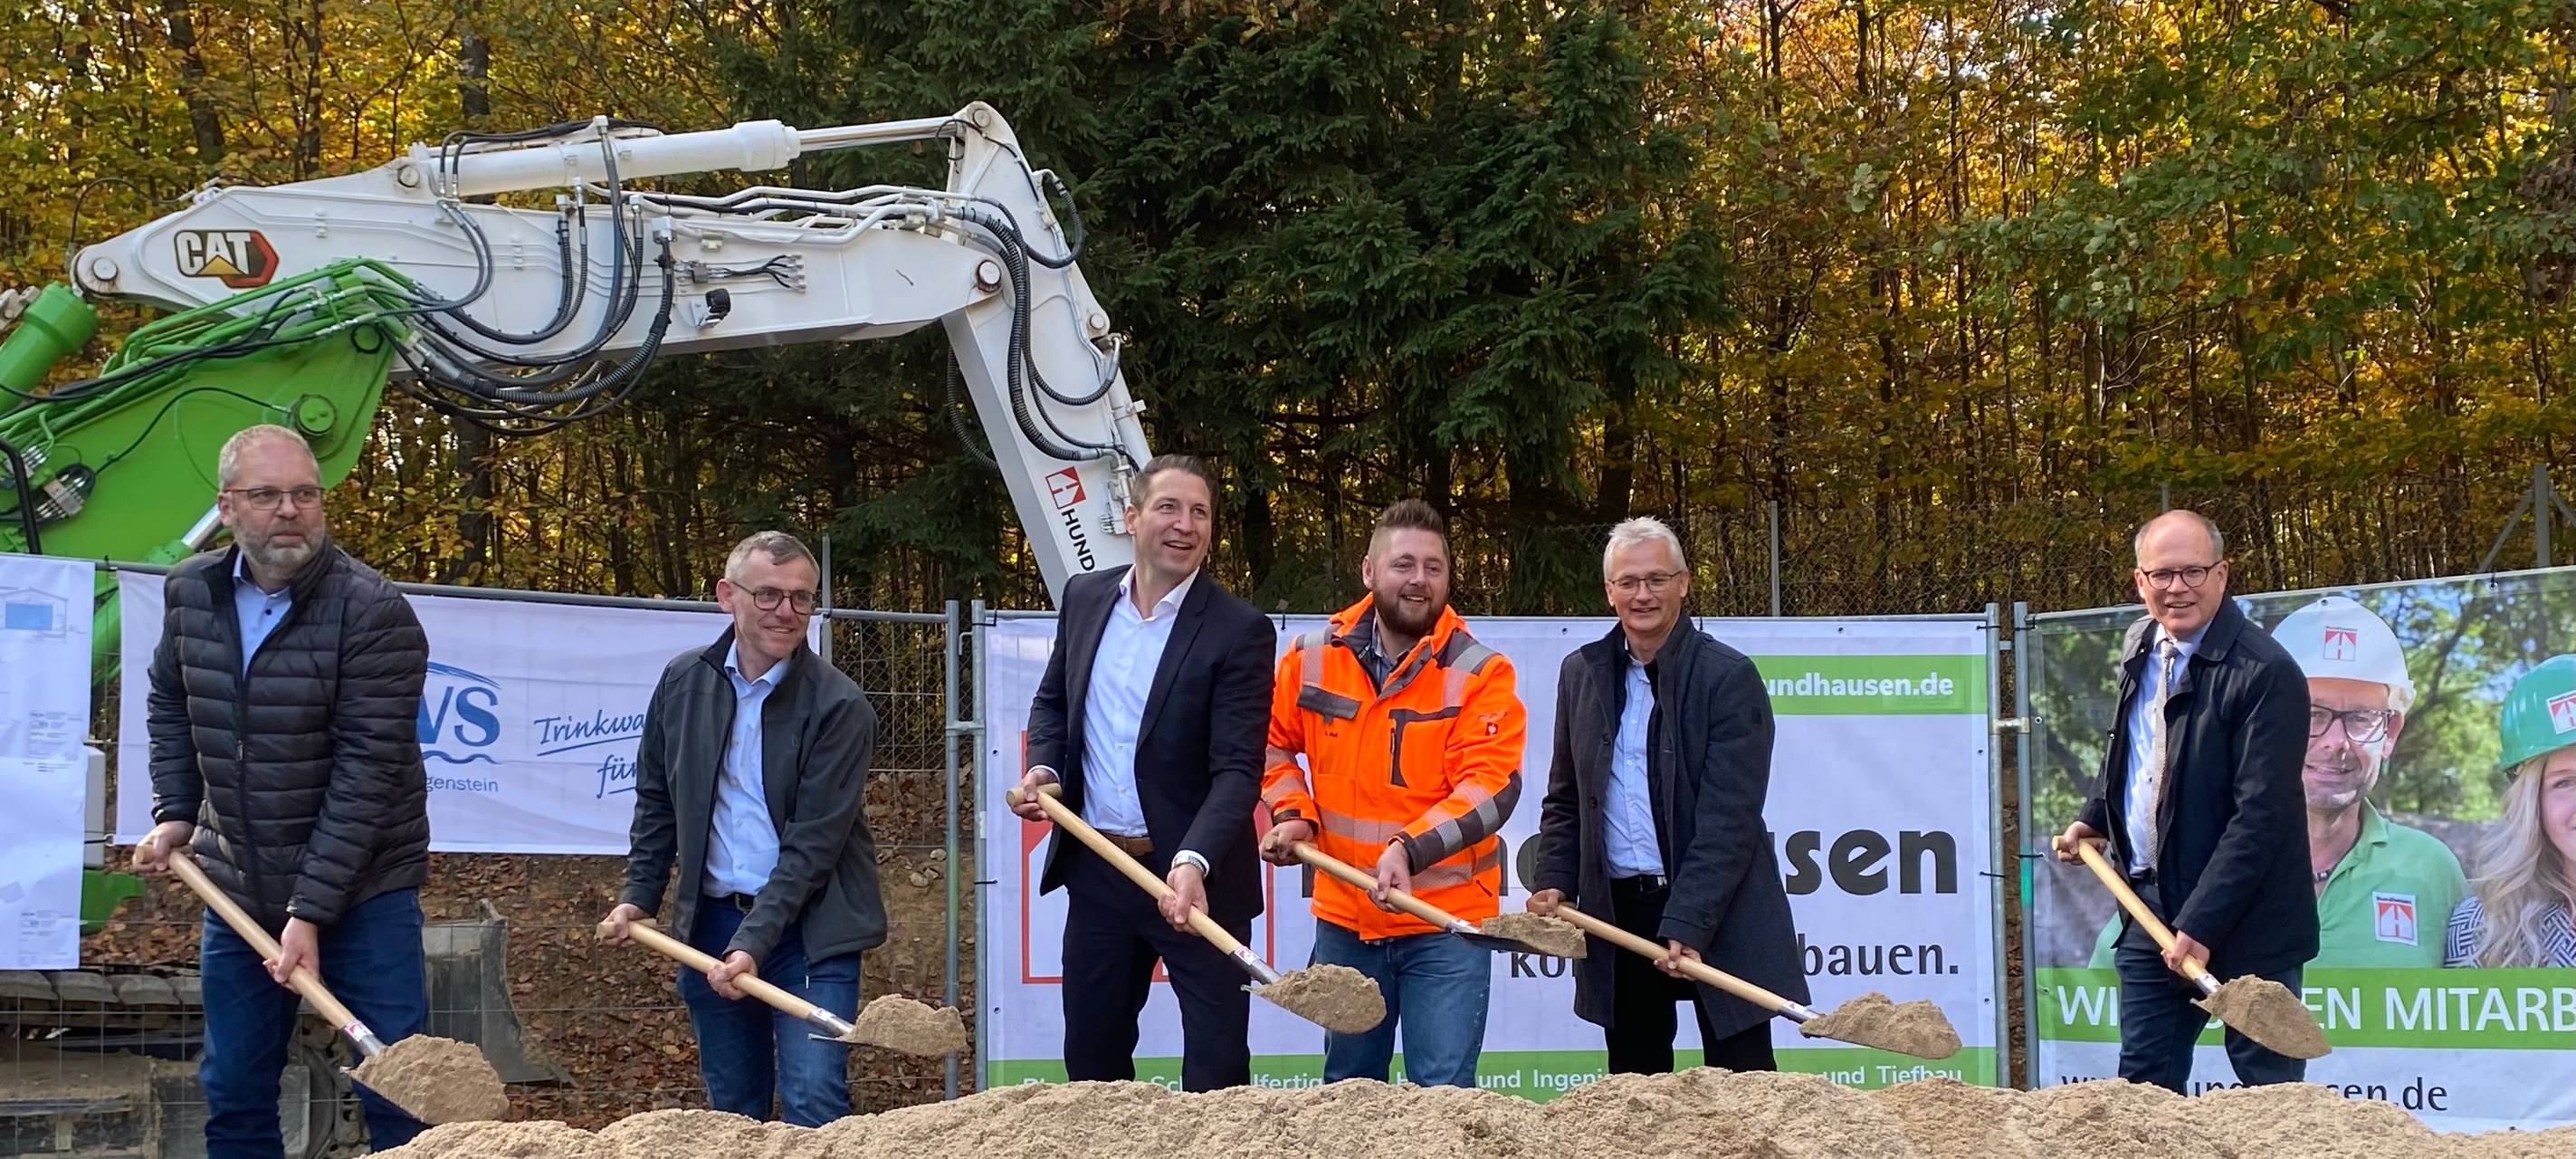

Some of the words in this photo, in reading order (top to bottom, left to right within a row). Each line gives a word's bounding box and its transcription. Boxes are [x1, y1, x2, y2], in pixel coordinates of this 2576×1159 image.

[176, 231, 252, 275] CAT
[1061, 508, 1095, 571] HUND
[1798, 934, 1959, 976] bauen.
[2386, 987, 2576, 1032] MITARB
[1478, 1070, 1521, 1088] und
